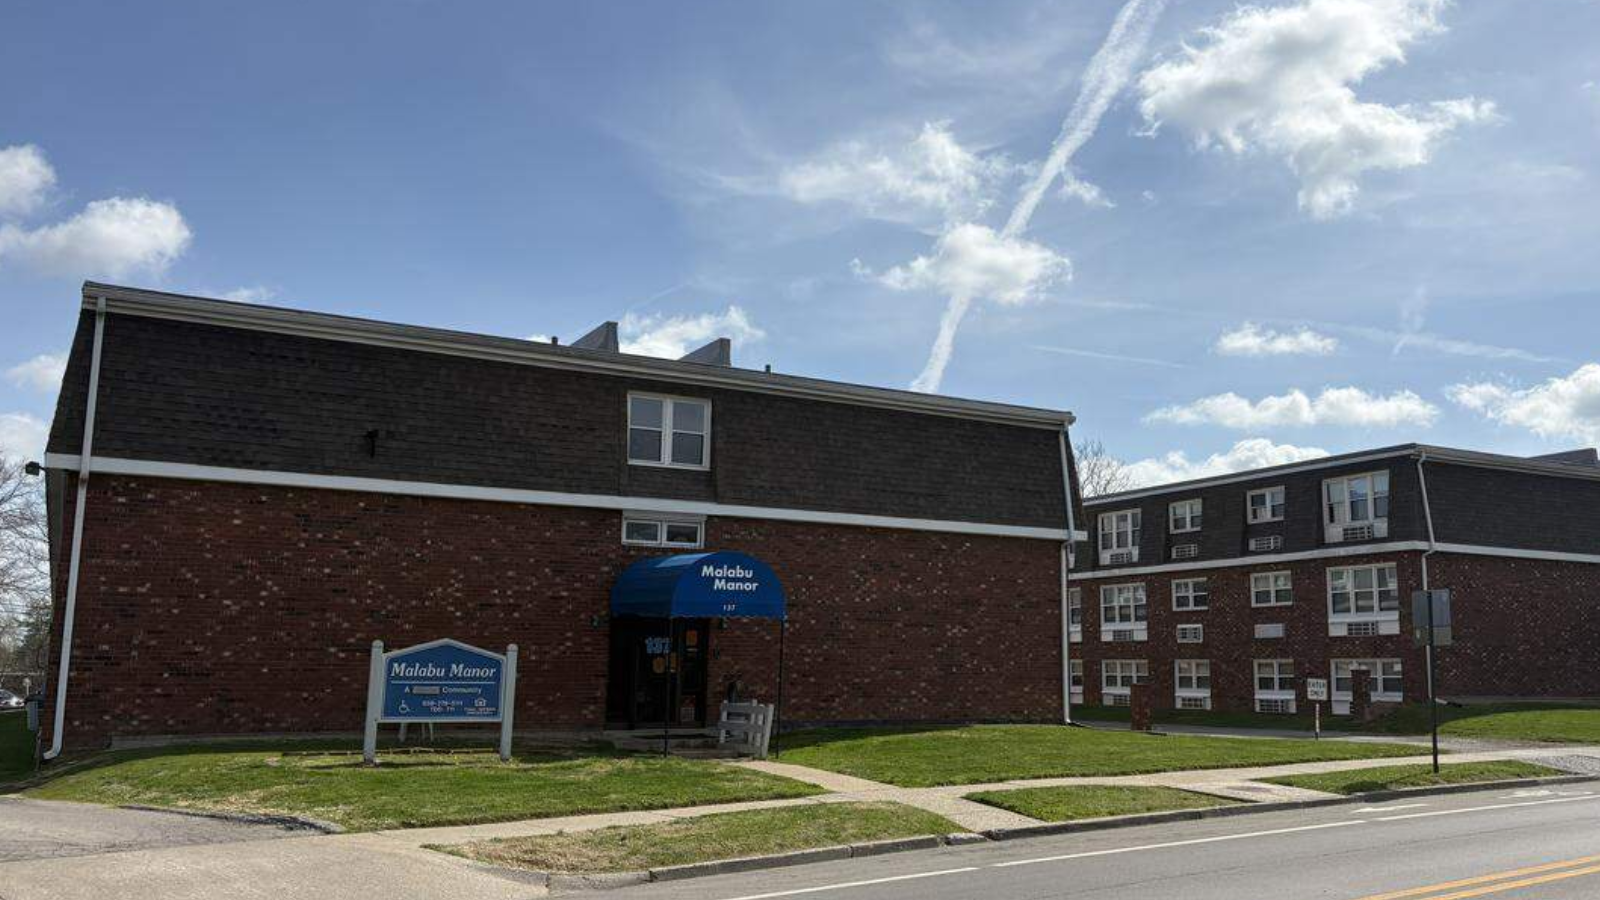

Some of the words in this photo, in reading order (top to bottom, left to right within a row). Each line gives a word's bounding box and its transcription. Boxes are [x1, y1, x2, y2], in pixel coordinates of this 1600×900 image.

[700, 564, 754, 578] Malabu
[713, 578, 759, 591] Manor
[390, 662, 445, 677] Malabu
[449, 663, 496, 677] Manor
[442, 685, 482, 695] Community
